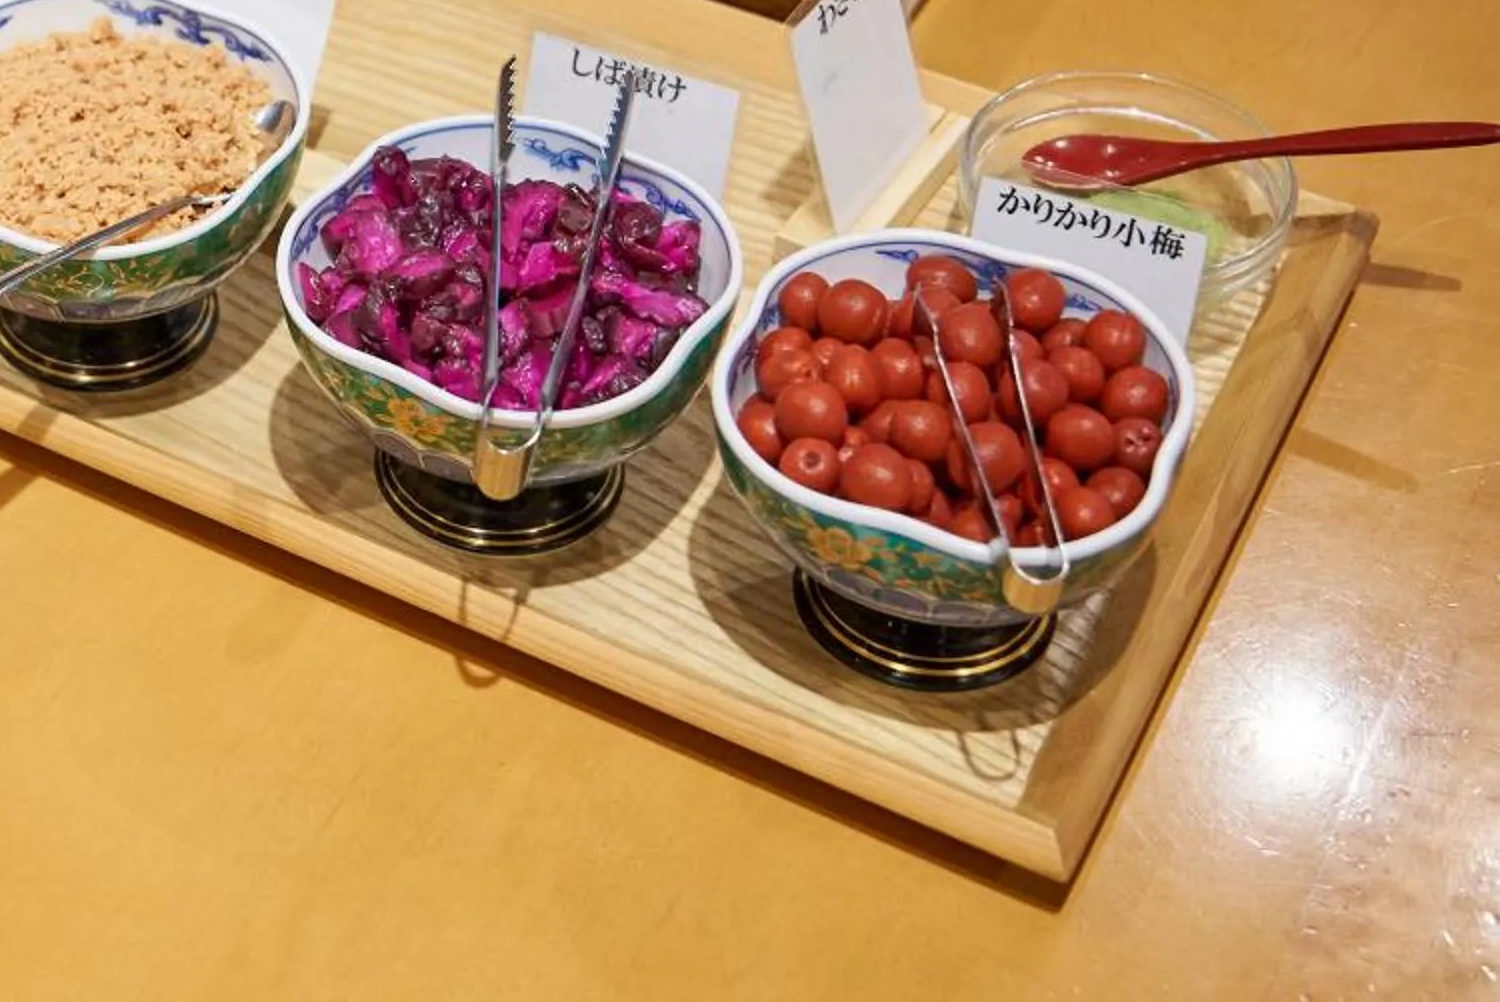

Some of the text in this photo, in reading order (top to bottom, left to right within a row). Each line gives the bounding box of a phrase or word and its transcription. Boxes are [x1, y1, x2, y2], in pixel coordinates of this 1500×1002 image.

[571, 47, 688, 103] しば漬け
[997, 186, 1186, 261] かりかり小梅
